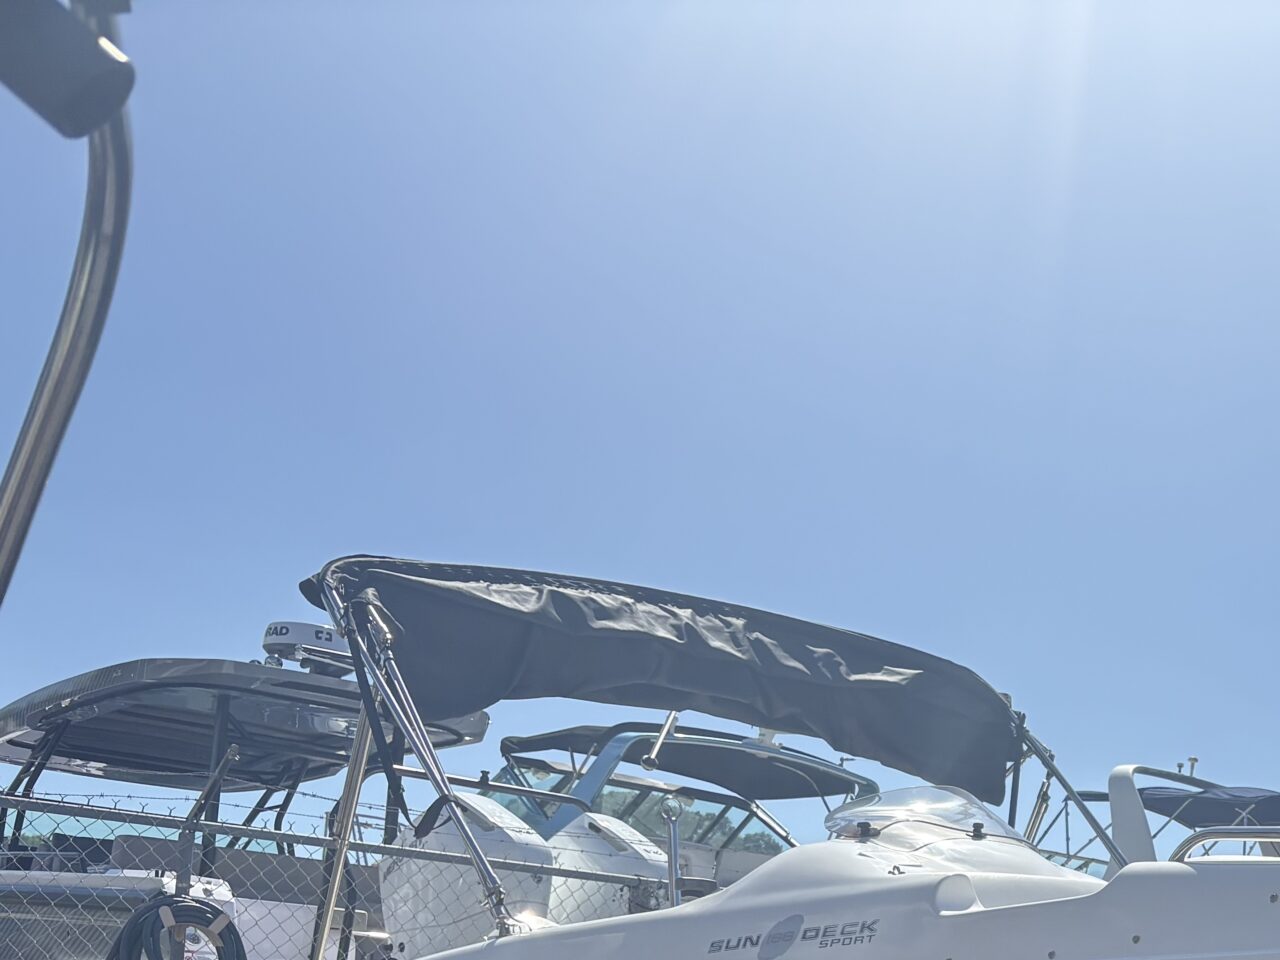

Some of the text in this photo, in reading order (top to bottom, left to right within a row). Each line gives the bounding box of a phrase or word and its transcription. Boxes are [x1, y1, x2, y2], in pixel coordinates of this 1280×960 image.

[707, 934, 763, 955] SUN
[800, 918, 881, 942] DECK
[818, 934, 876, 949] SPORT
